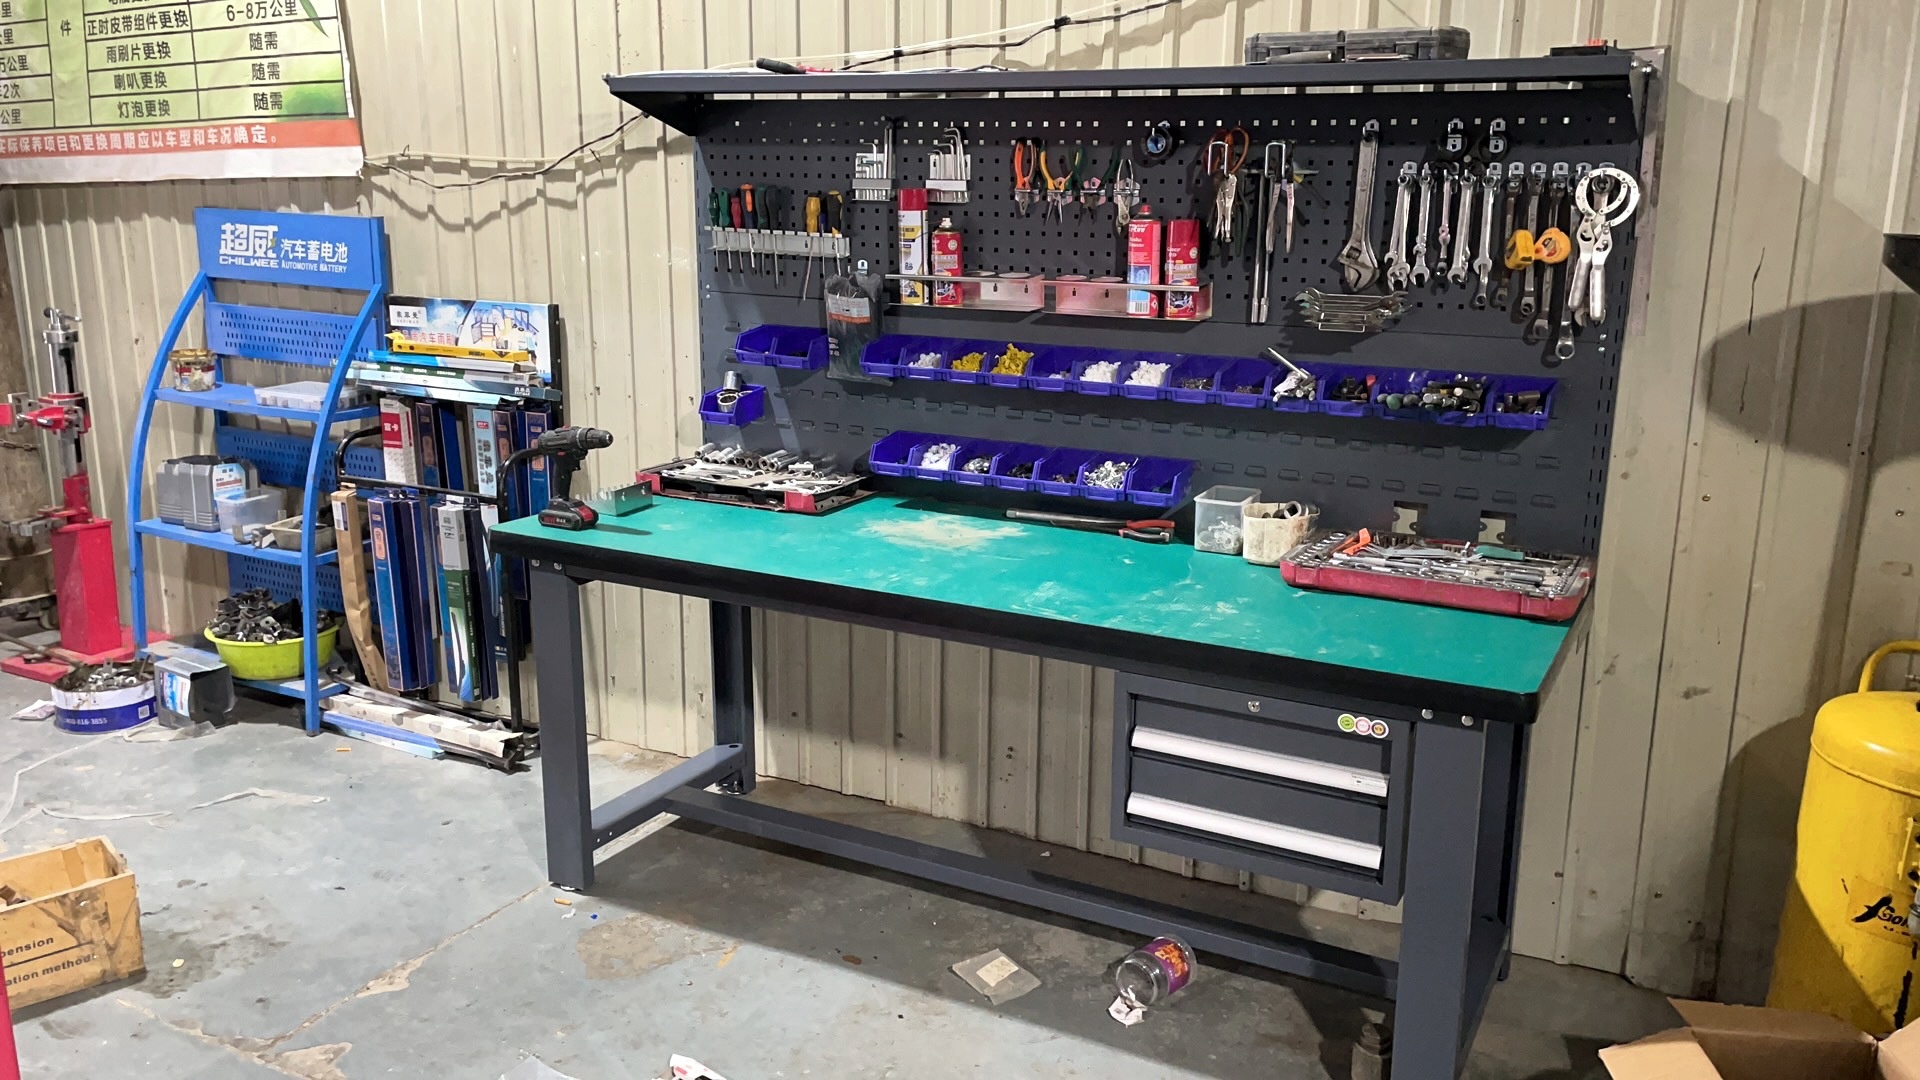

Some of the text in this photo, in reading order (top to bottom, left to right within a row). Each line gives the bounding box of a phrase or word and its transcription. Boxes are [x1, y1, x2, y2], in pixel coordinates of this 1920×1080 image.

[226, 0, 298, 21] 6-8万公里
[60, 19, 71, 37] 件
[87, 9, 190, 36] 正时皮带组件更换
[249, 31, 278, 51] 随需
[106, 41, 171, 63] 雨刷片更换
[113, 71, 168, 91] 喇叭更换
[251, 62, 280, 81] 随需
[0, 82, 21, 99] 2次
[117, 99, 171, 118] 灯泡更换
[253, 91, 283, 111] 随需
[219, 222, 279, 259] 超威
[280, 238, 348, 264] 汽车蓄电池
[219, 255, 279, 269] CHILWEE
[319, 263, 347, 273] BATTERY
